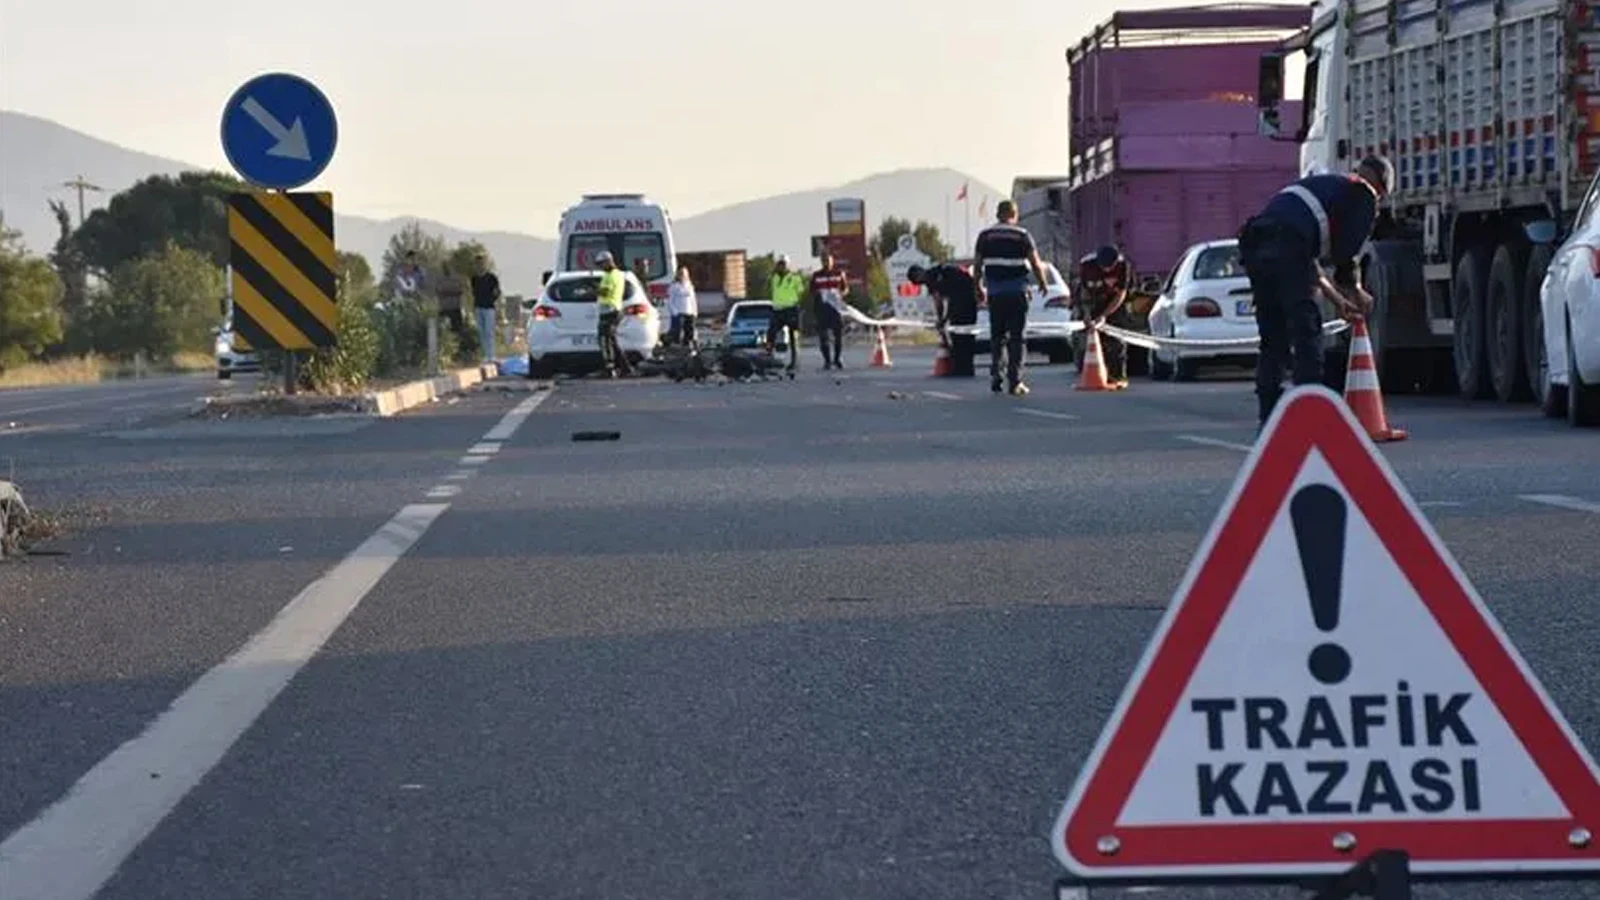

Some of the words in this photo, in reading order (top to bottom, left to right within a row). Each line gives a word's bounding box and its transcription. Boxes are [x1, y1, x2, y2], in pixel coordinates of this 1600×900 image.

[574, 218, 653, 231] AMBULANS
[1191, 680, 1477, 750] TRAFİK
[1196, 758, 1481, 816] KAZASI
